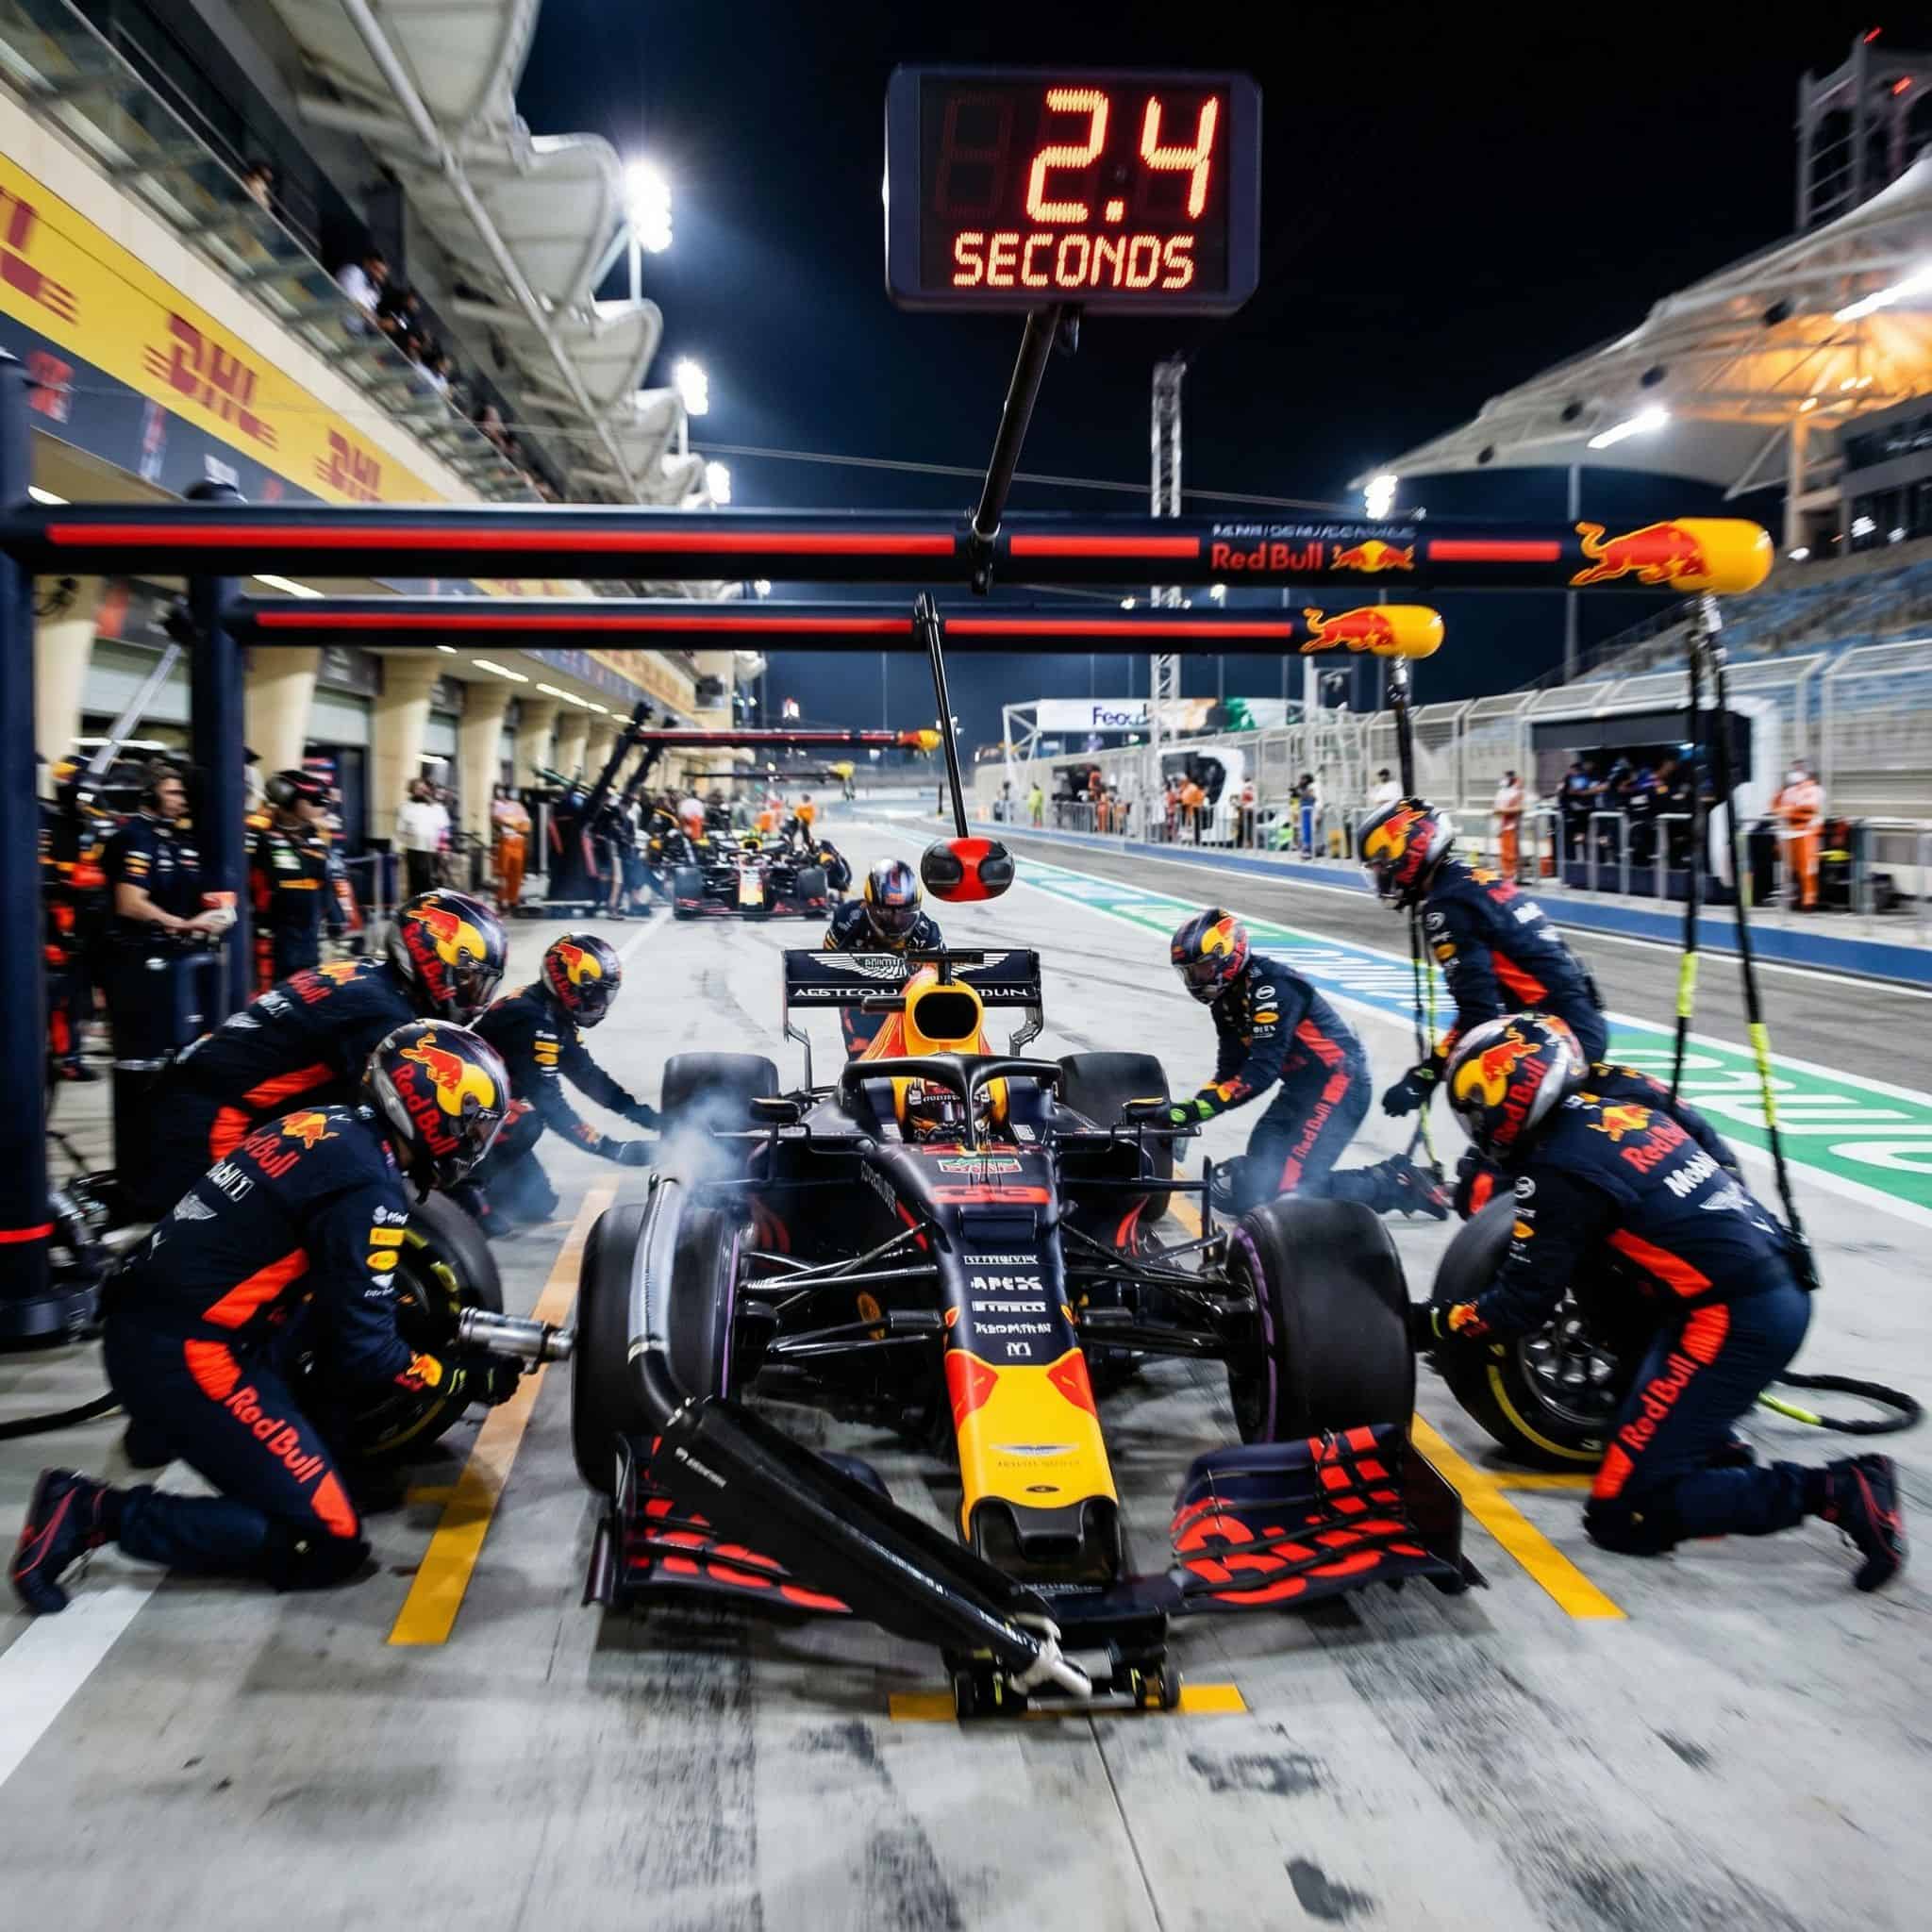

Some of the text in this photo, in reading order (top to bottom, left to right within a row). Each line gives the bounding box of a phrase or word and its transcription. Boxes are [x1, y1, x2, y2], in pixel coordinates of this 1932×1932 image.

[1026, 88, 1218, 223] 2.4
[953, 232, 1195, 290] SECONDS
[1211, 542, 1324, 571] Red Bull
[392, 1062, 460, 1156] Red Bull
[224, 1385, 325, 1484] Red Bull
[1619, 1352, 1699, 1451] Red Bull
